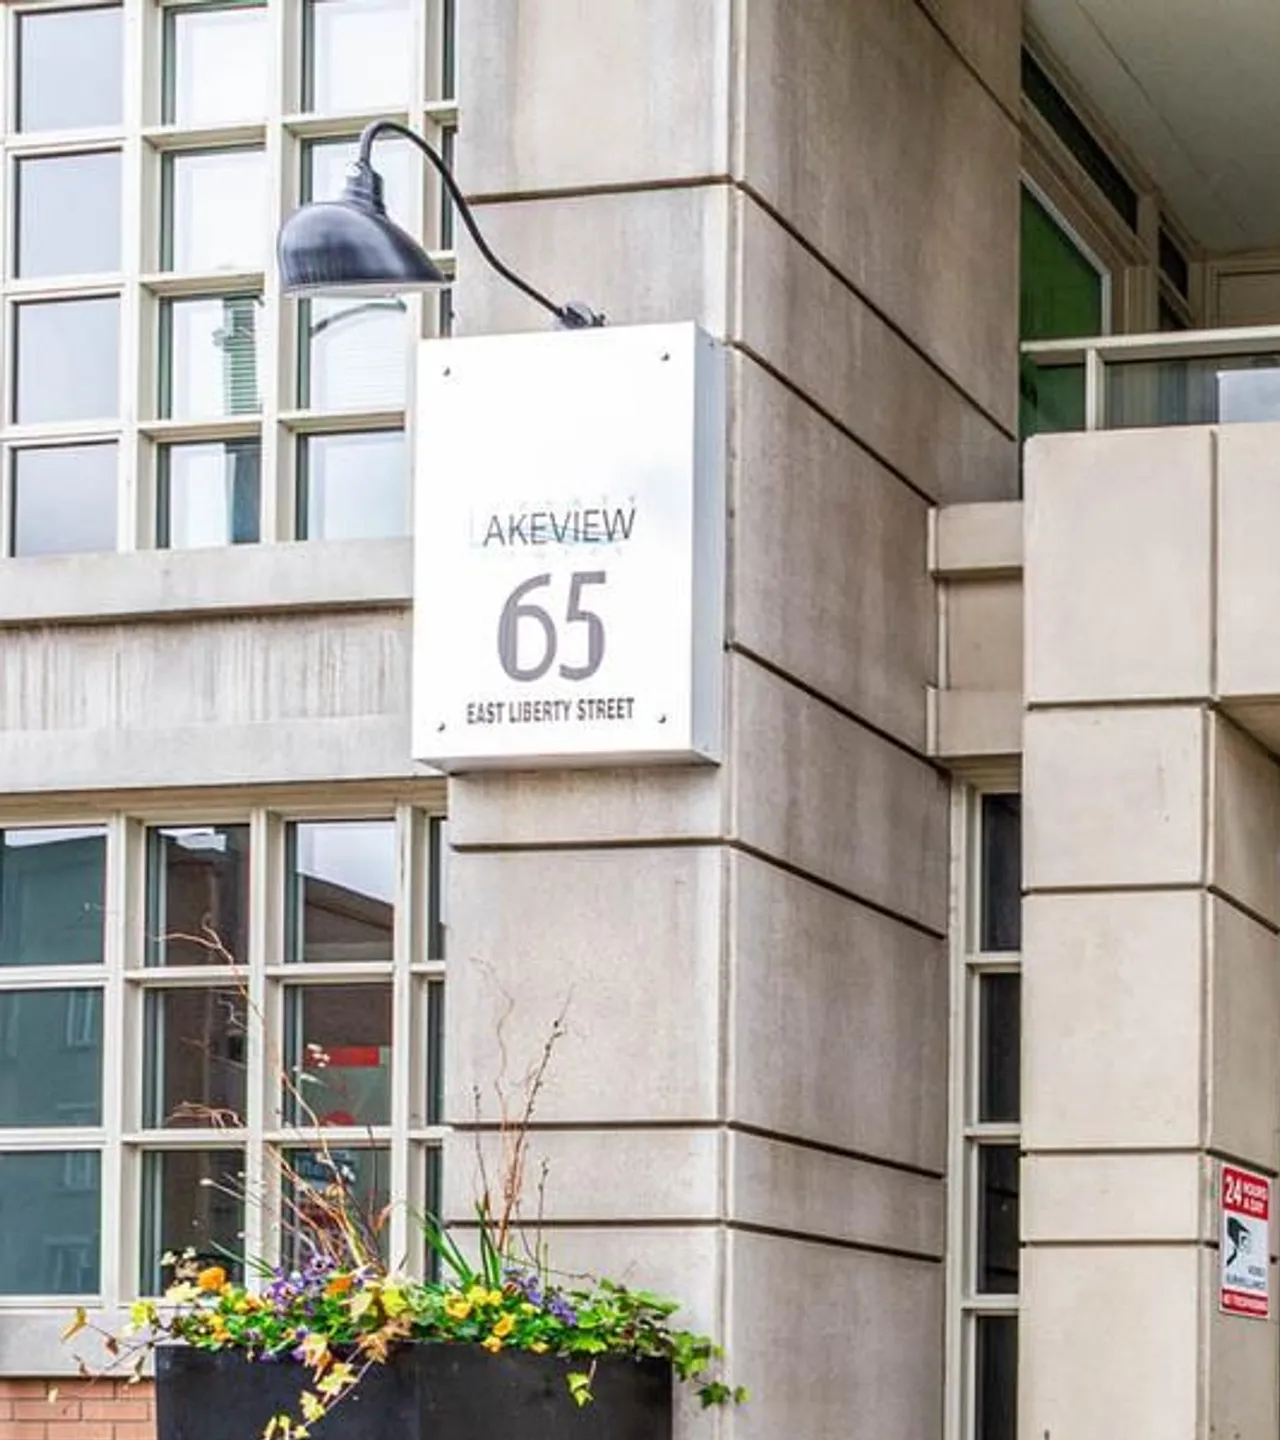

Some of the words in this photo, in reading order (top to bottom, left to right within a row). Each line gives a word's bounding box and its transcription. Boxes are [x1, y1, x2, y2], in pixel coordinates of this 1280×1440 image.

[497, 570, 607, 683] 65
[466, 701, 506, 725] EAST
[509, 699, 573, 724] LIBERTY
[576, 696, 636, 721] STREET
[1224, 1174, 1243, 1206] 24
